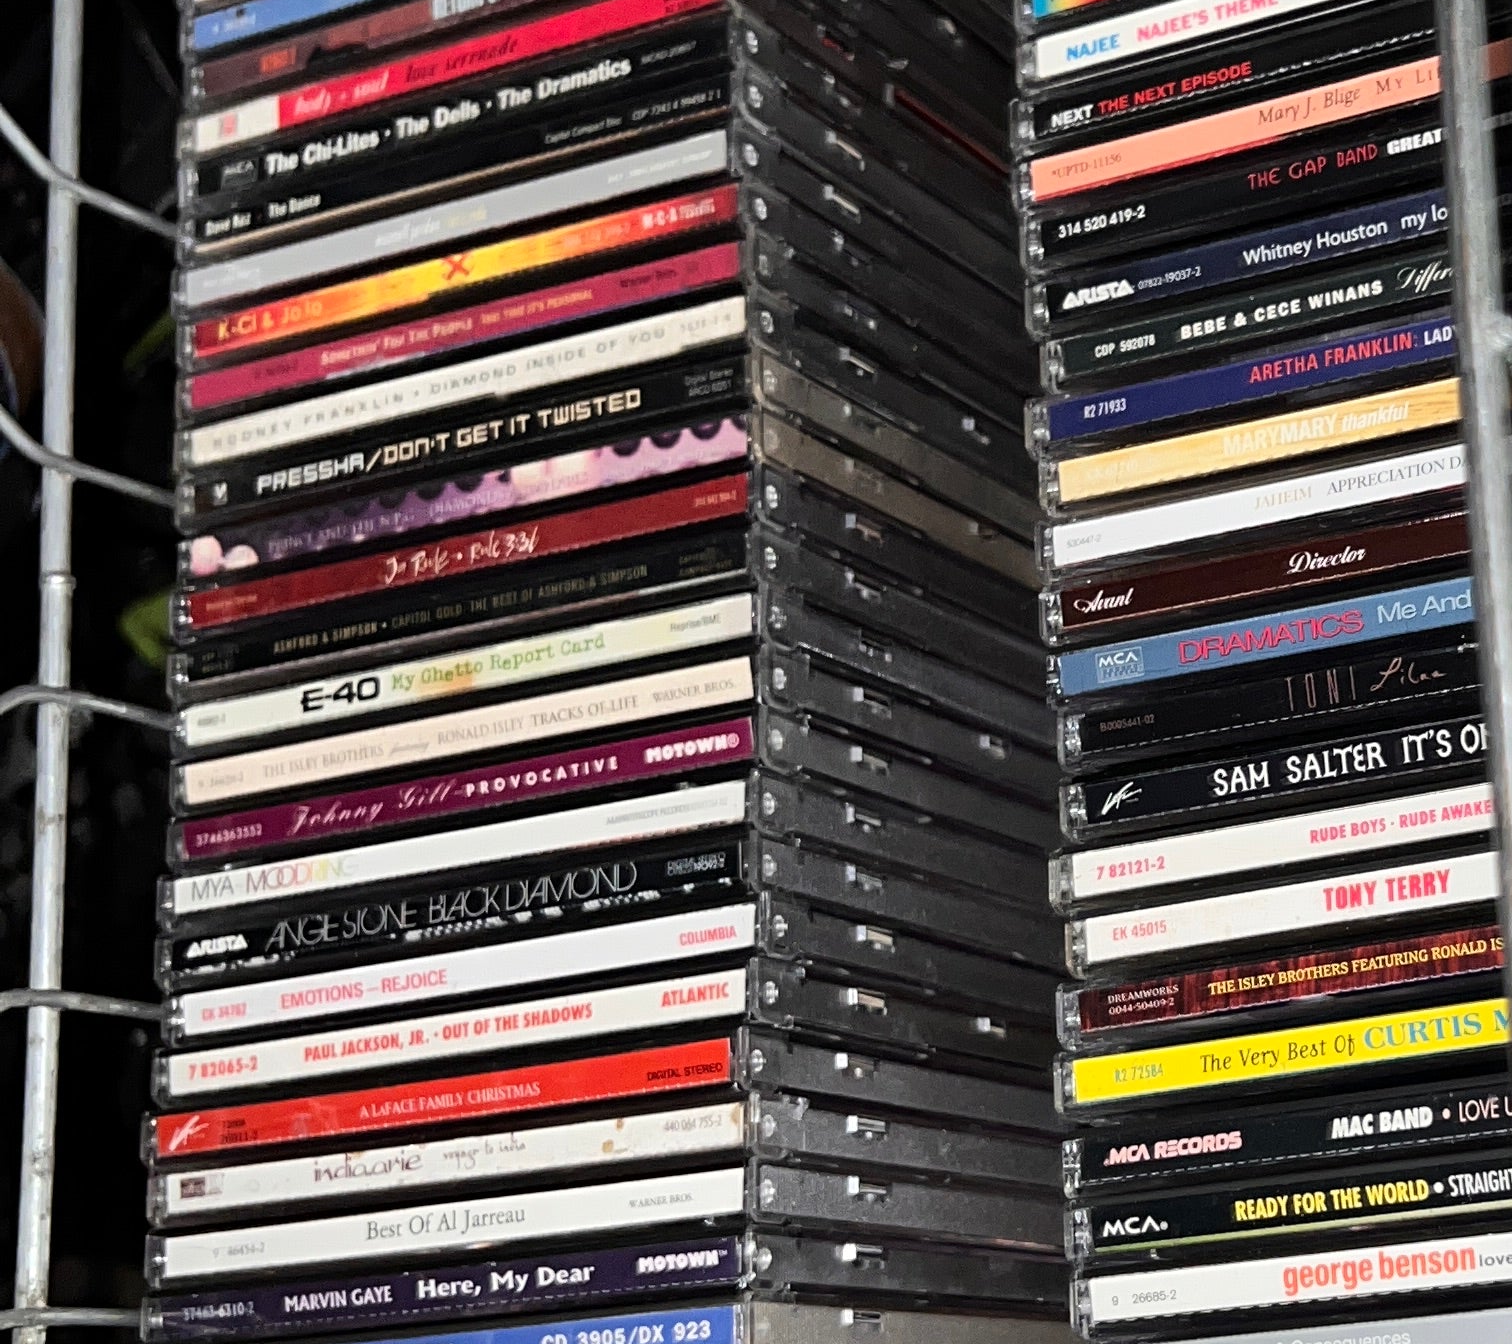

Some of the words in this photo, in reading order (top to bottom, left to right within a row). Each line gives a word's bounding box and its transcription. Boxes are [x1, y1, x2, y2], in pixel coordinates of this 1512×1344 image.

[1066, 34, 1120, 61] NAJEE
[1136, 9, 1209, 42] NAJEE'S
[265, 153, 298, 174] The
[303, 129, 379, 165] Chi-Lites
[395, 116, 429, 139] The
[434, 99, 481, 129] Dells
[498, 86, 532, 110] The
[537, 58, 632, 100] Dramatics
[1051, 105, 1093, 128] NEXT
[1099, 94, 1128, 114] THE
[1134, 83, 1176, 105] NEXT
[1181, 61, 1252, 94] EPISODE
[1058, 223, 1081, 238] 314
[1084, 217, 1106, 232] 520
[1109, 205, 1146, 227] 419-2
[1247, 168, 1281, 191] THE
[1288, 157, 1327, 179] GAP
[1336, 143, 1378, 167] BAND
[1243, 237, 1312, 266] Whitney
[1317, 220, 1388, 250] Houston
[1400, 212, 1427, 231] my
[1180, 317, 1226, 339] BEBE
[1234, 313, 1248, 327] &
[1254, 298, 1301, 323] CECE
[1307, 280, 1383, 310] WINANS
[1249, 354, 1318, 384] ARETHA
[457, 420, 503, 448] GET
[510, 415, 530, 436] IT
[537, 388, 641, 426] TWISTED
[1099, 651, 1138, 668] MCA
[1178, 610, 1365, 664] DRAMATICS
[1377, 605, 1418, 624] Me
[1421, 590, 1471, 616] And
[301, 676, 380, 712] E-40
[392, 673, 415, 691] My
[421, 660, 484, 683] Ghetto
[490, 646, 555, 672] Report
[561, 633, 605, 655] Card
[1109, 856, 1165, 878] 82121-2
[1310, 827, 1346, 844] RUDE
[1350, 818, 1386, 836] BOYS
[1399, 809, 1436, 828] RUDE
[1323, 881, 1377, 912] TONY
[1385, 869, 1450, 902] TERRY
[201, 1056, 258, 1078] 82065-2
[304, 1046, 337, 1061] PAUL
[341, 1034, 404, 1057] JACKSON,
[409, 1031, 430, 1046] JR.
[442, 1023, 469, 1040] OUT
[474, 1019, 491, 1035] OF
[495, 1015, 519, 1032] THE
[524, 1003, 593, 1028] SHADOWS
[661, 982, 729, 1007] ATLANTIC
[1200, 1053, 1231, 1073] The
[1239, 1047, 1280, 1069] Very
[1288, 1040, 1326, 1061] Best
[1334, 1033, 1356, 1056] Of
[1364, 1012, 1482, 1049] CURTIS
[1331, 1116, 1374, 1140] MAC
[1379, 1106, 1433, 1133] BAND
[1459, 1098, 1498, 1122] LOVE
[1234, 1195, 1289, 1222] READY
[1294, 1191, 1326, 1214] FOR
[1330, 1187, 1362, 1208] THE
[1366, 1180, 1429, 1205] WORLD
[284, 1290, 347, 1312] MARVIN
[350, 1285, 393, 1306] GAYE
[416, 1276, 482, 1299] Here,
[490, 1268, 528, 1292] My
[537, 1265, 595, 1287] Dear
[1283, 1257, 1373, 1296] george
[1378, 1247, 1475, 1280] benson
[674, 1320, 711, 1340] 923
